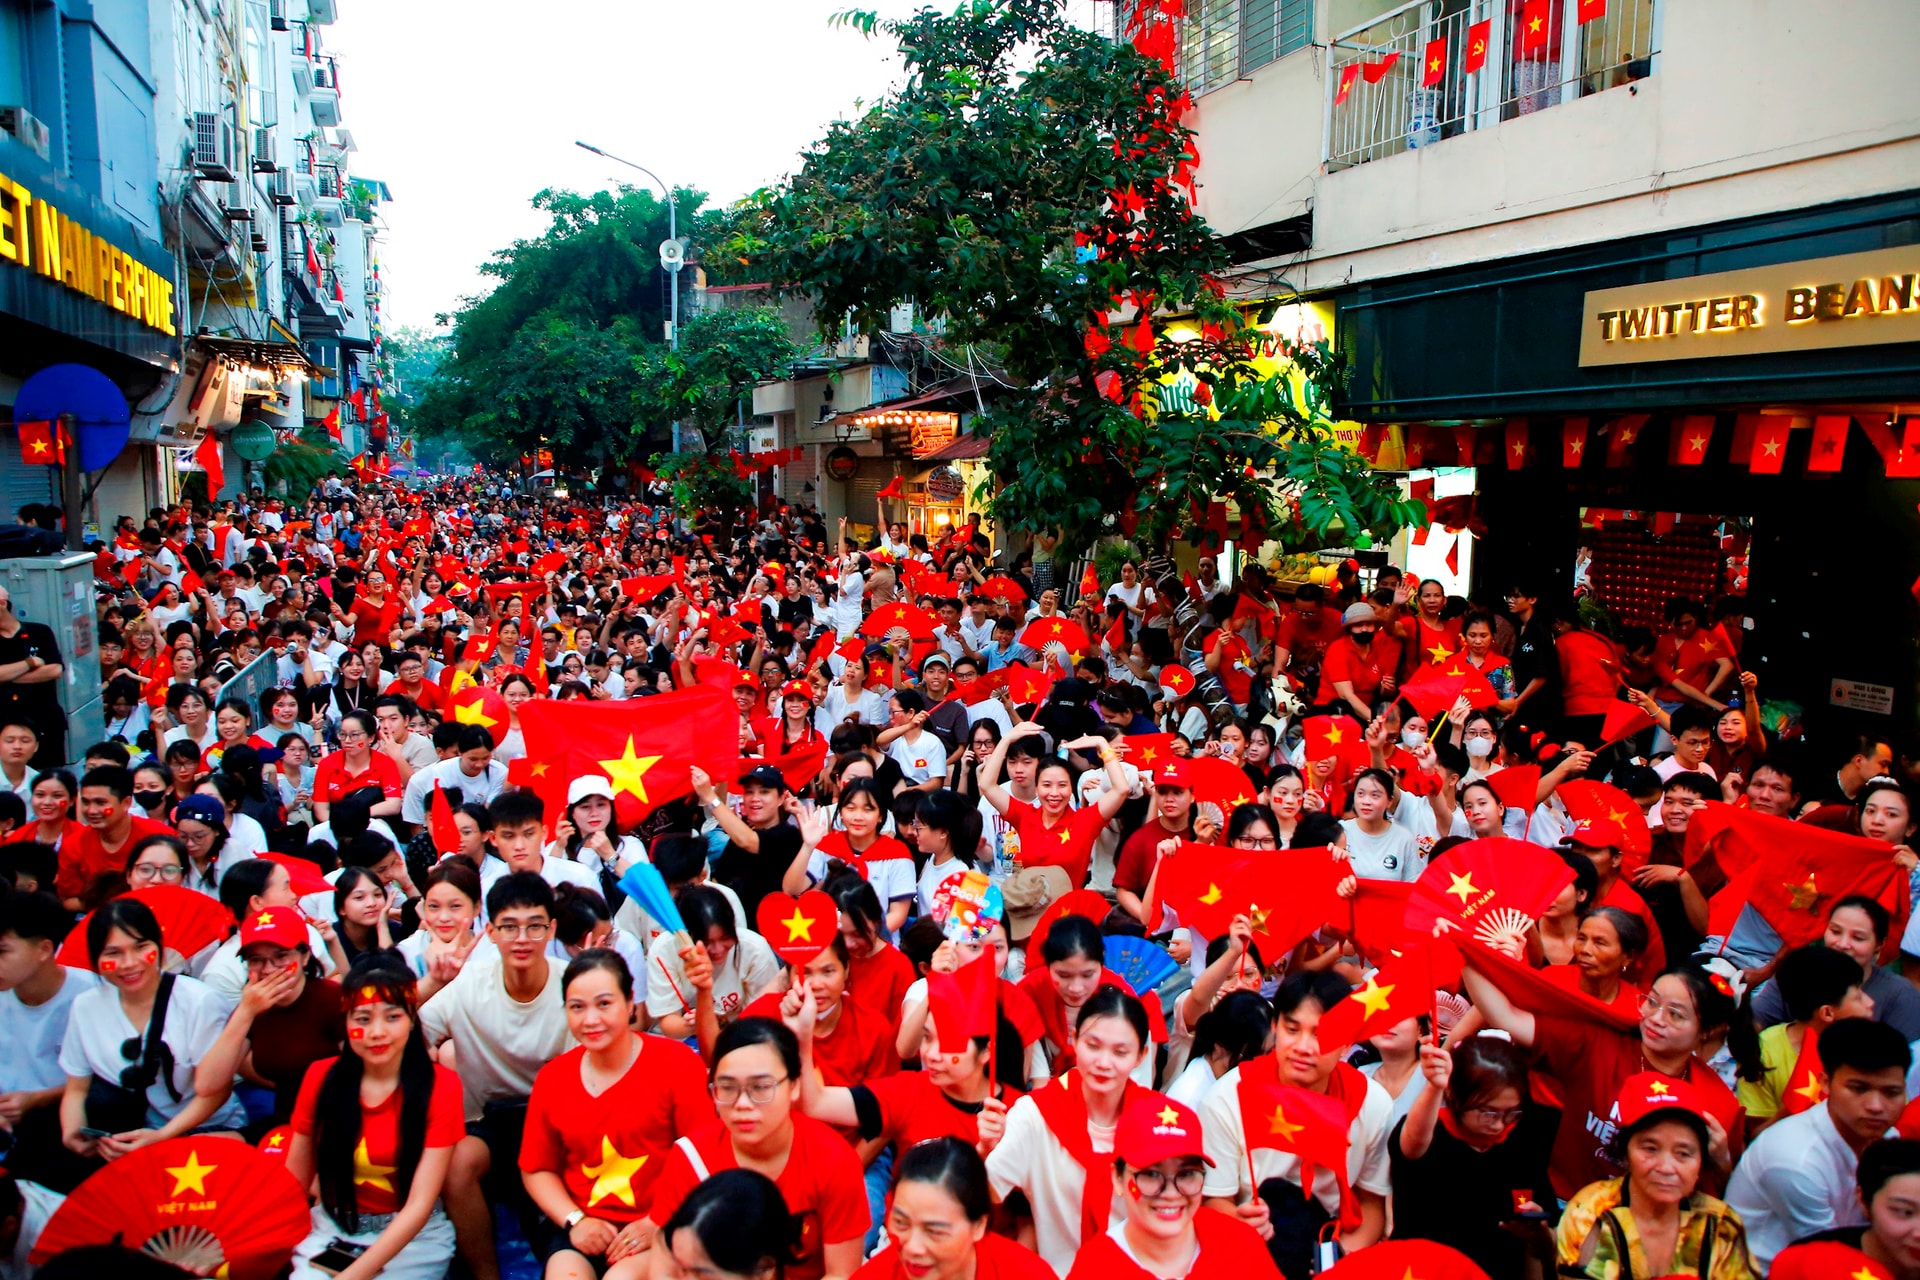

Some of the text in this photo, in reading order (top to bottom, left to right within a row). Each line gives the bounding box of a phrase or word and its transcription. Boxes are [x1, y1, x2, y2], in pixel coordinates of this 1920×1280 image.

[32, 199, 95, 298] NAM
[91, 236, 176, 337] PERFUME
[1598, 273, 1920, 341] TWITTER BEAN
[1460, 889, 1496, 919] VIỆT NAM
[1585, 1110, 1620, 1145] VIỆ
[188, 1200, 217, 1211] NAM
